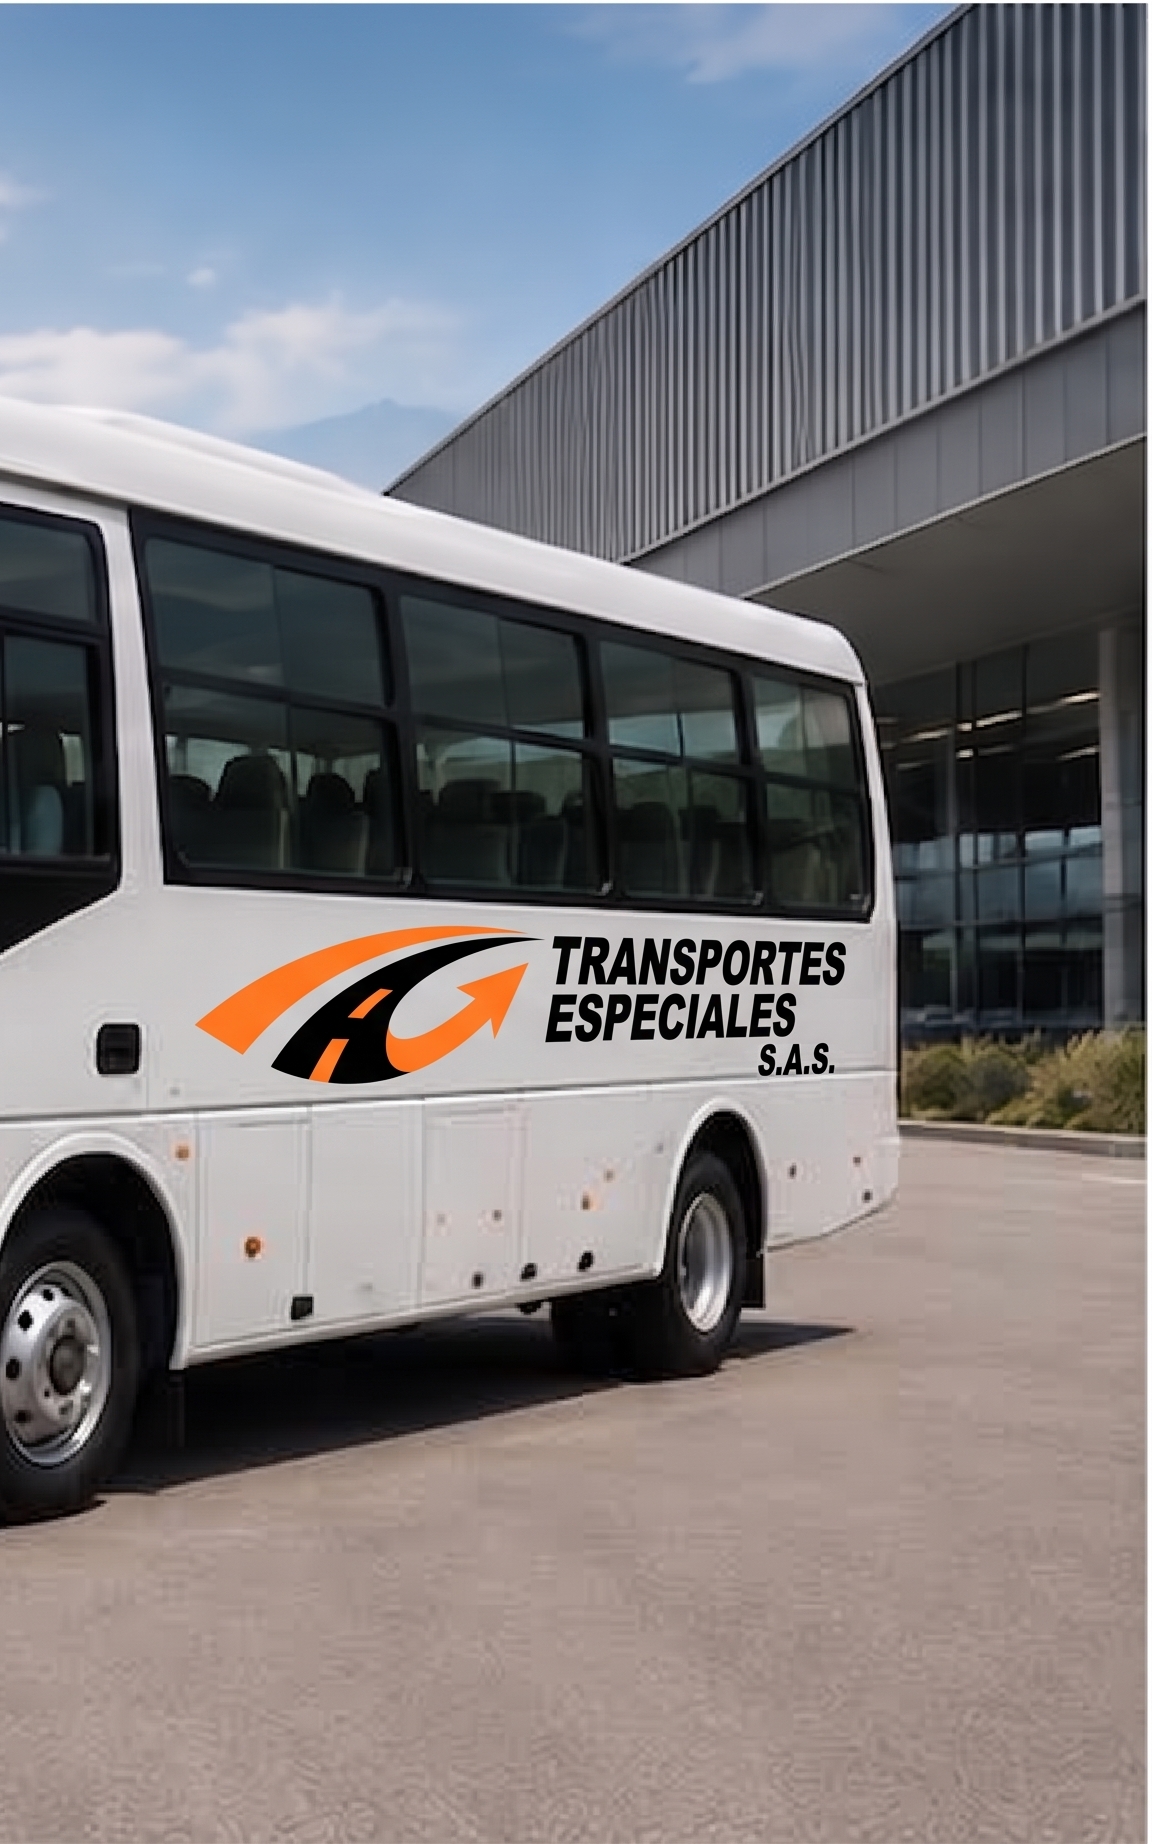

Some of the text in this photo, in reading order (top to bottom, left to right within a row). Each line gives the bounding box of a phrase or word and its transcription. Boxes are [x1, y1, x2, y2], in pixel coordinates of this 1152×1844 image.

[552, 935, 847, 986] TRANSPORTES
[545, 992, 797, 1043] ESPECIALES
[757, 1042, 835, 1077] S.A.S.
